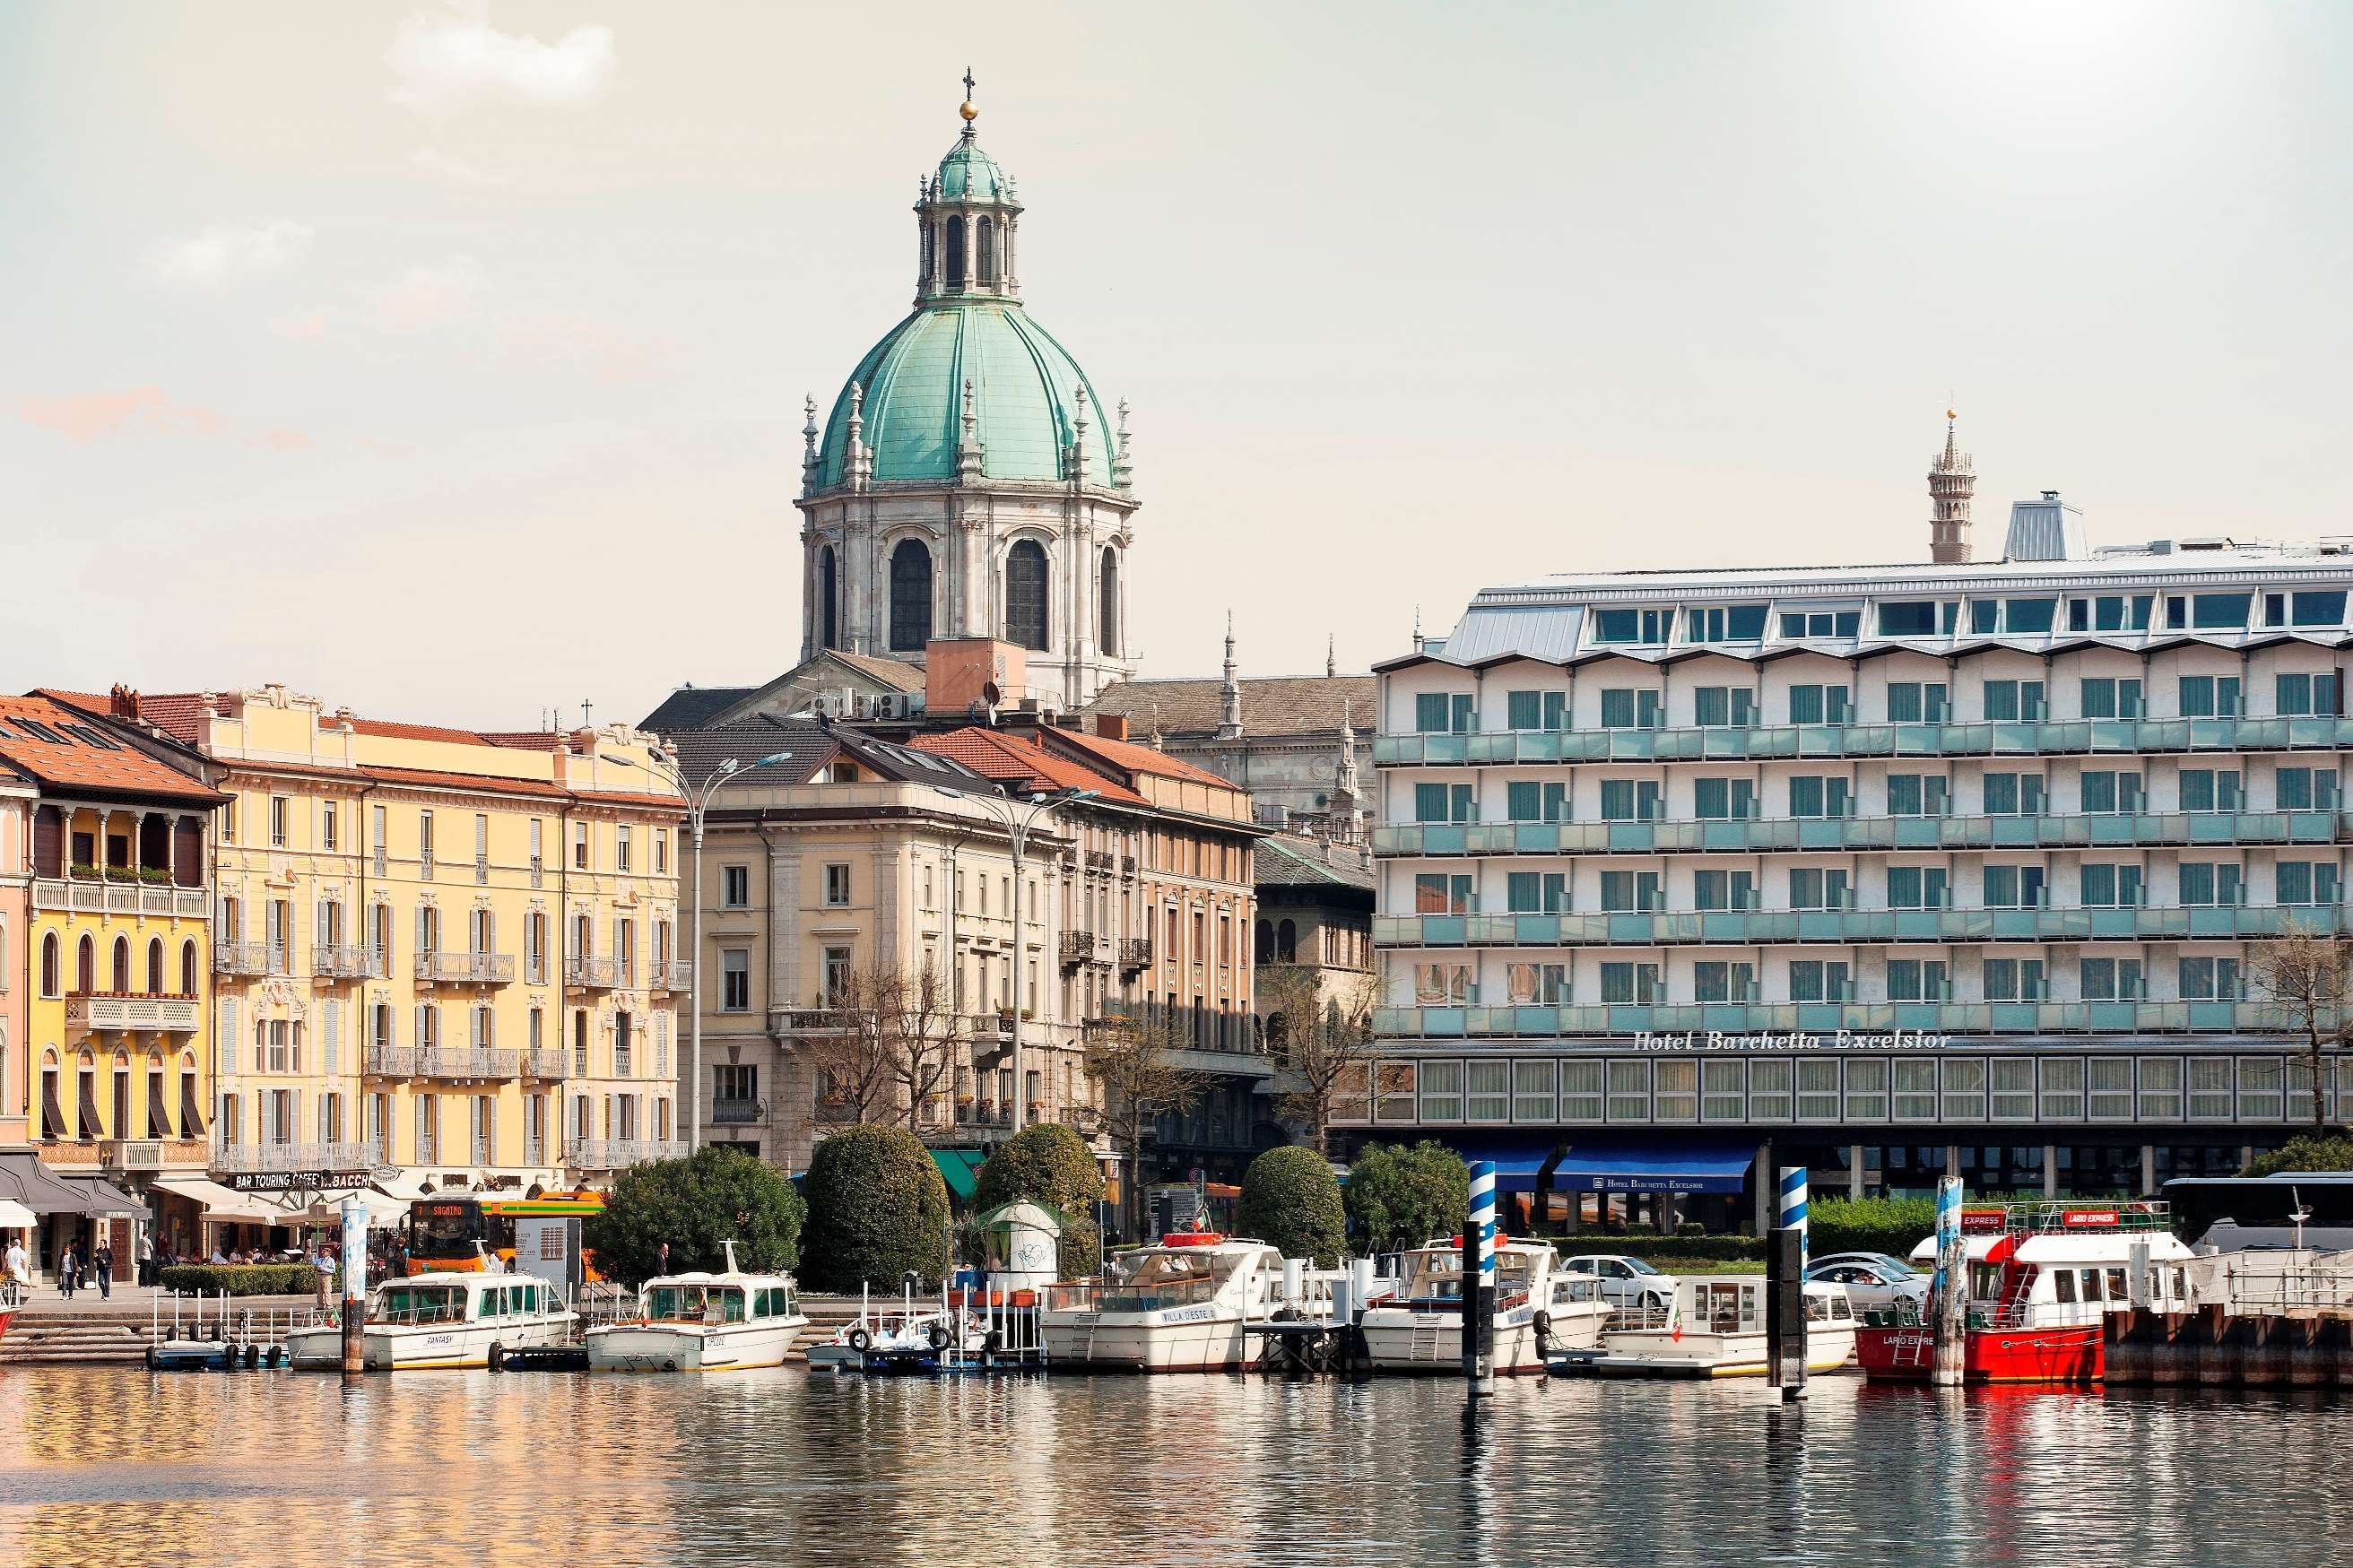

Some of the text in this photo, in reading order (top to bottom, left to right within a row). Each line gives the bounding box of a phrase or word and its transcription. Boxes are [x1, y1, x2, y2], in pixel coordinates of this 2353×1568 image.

[1632, 1028, 1951, 1051] Hotel Barchetta Excelsior
[236, 1175, 252, 1188] BAR
[255, 1174, 290, 1188] TOURING
[418, 1206, 463, 1216] 7 SAGNINO
[1964, 1217, 2000, 1225] EXPRESS
[2069, 1213, 2115, 1223] LARIO EXPRESS
[1162, 1312, 1184, 1322] VILLA
[1907, 1337, 1934, 1346] EXPRE
